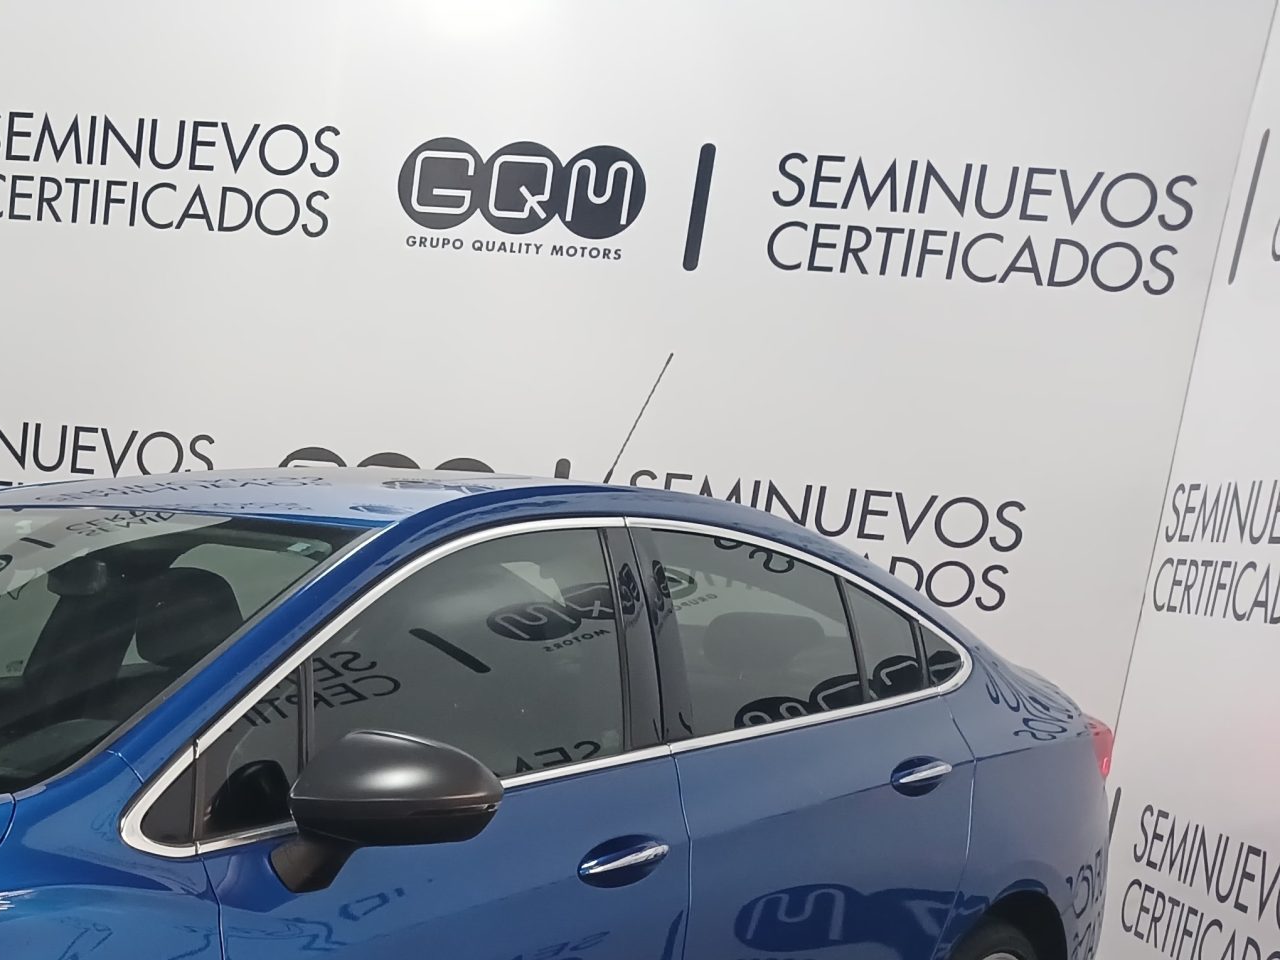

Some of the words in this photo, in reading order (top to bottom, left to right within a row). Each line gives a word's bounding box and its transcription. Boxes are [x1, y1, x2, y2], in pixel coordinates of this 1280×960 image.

[410, 150, 636, 226] GQM
[772, 152, 1198, 232] SEMINUEVOS
[406, 235, 464, 250] GRUPO
[471, 239, 543, 255] QUALITY
[550, 245, 623, 261] MOTORS
[767, 220, 1178, 296] CERTIFICADOS
[1133, 804, 1280, 931] SEMINUEV
